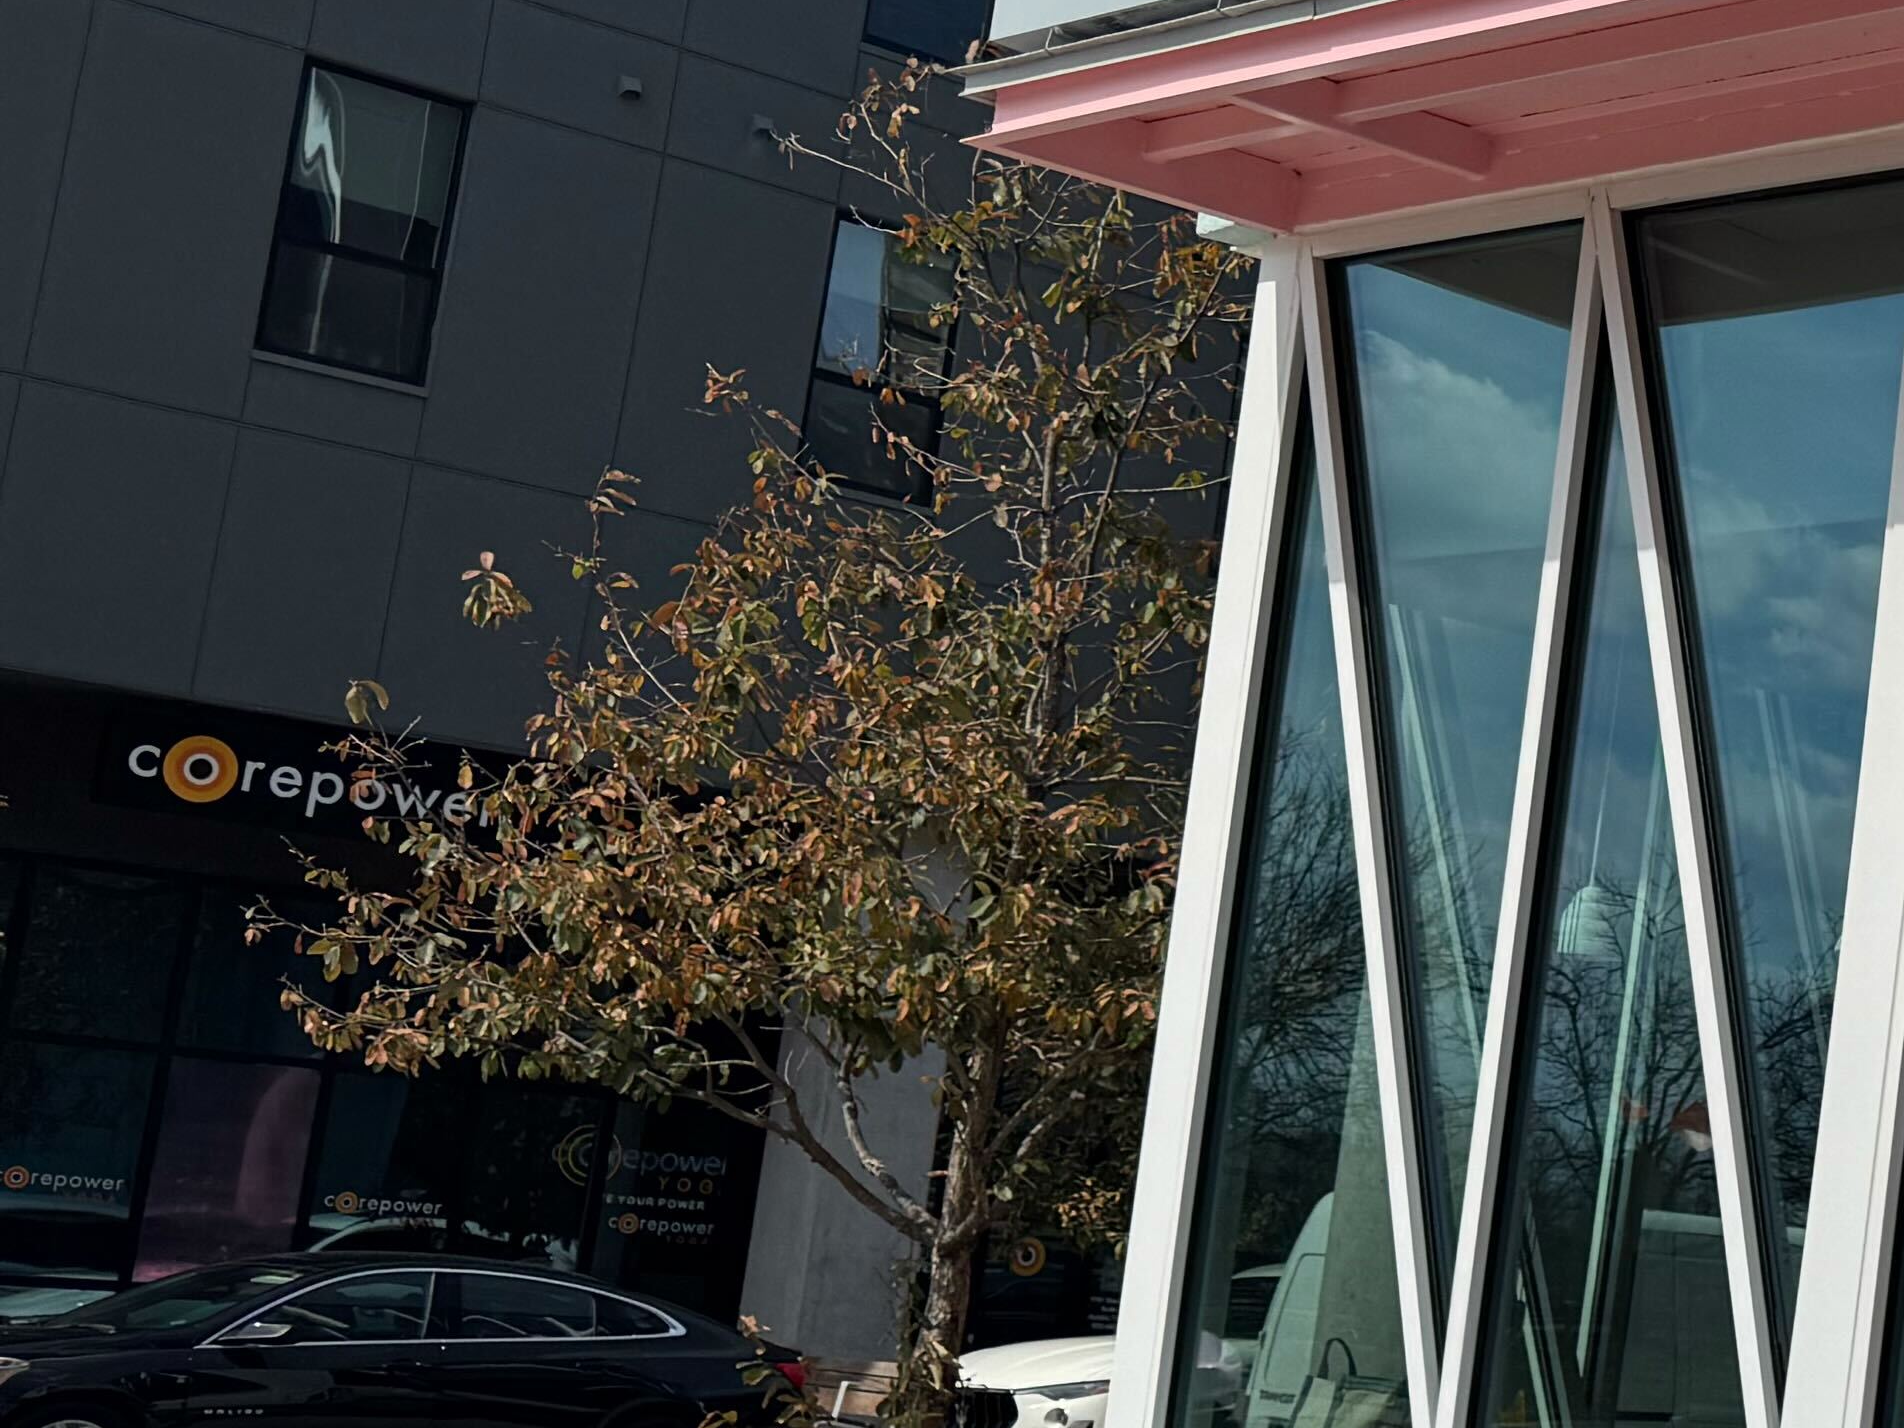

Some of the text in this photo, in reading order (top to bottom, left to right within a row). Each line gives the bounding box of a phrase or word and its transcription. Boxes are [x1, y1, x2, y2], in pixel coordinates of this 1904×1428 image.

[0, 1166, 125, 1192] orepower
[324, 1191, 443, 1216] corepower
[608, 1213, 715, 1236] corepower
